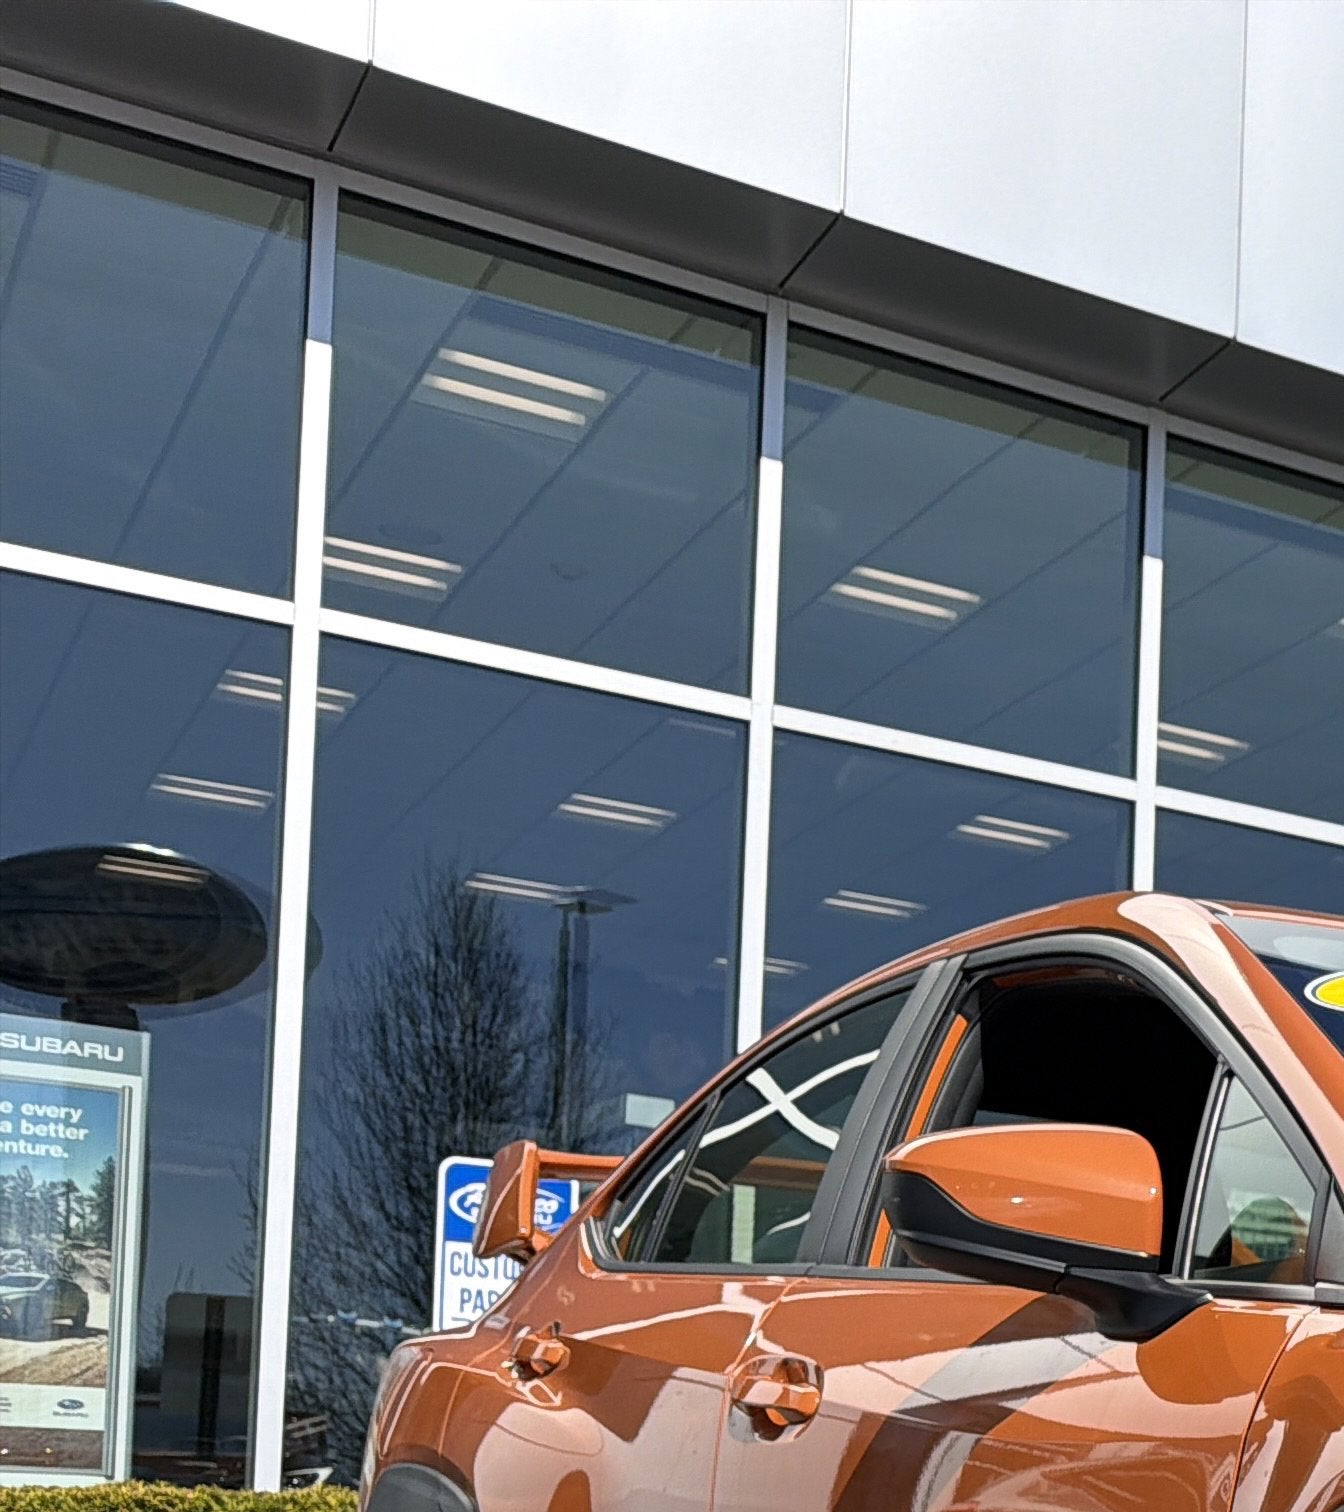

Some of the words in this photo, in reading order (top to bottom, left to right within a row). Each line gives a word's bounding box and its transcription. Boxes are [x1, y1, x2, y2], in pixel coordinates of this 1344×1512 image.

[0, 1032, 124, 1063] SUBARU
[20, 1102, 84, 1124] every
[20, 1119, 90, 1141] better
[0, 1138, 69, 1159] nture.
[449, 1251, 524, 1280] CUSTO
